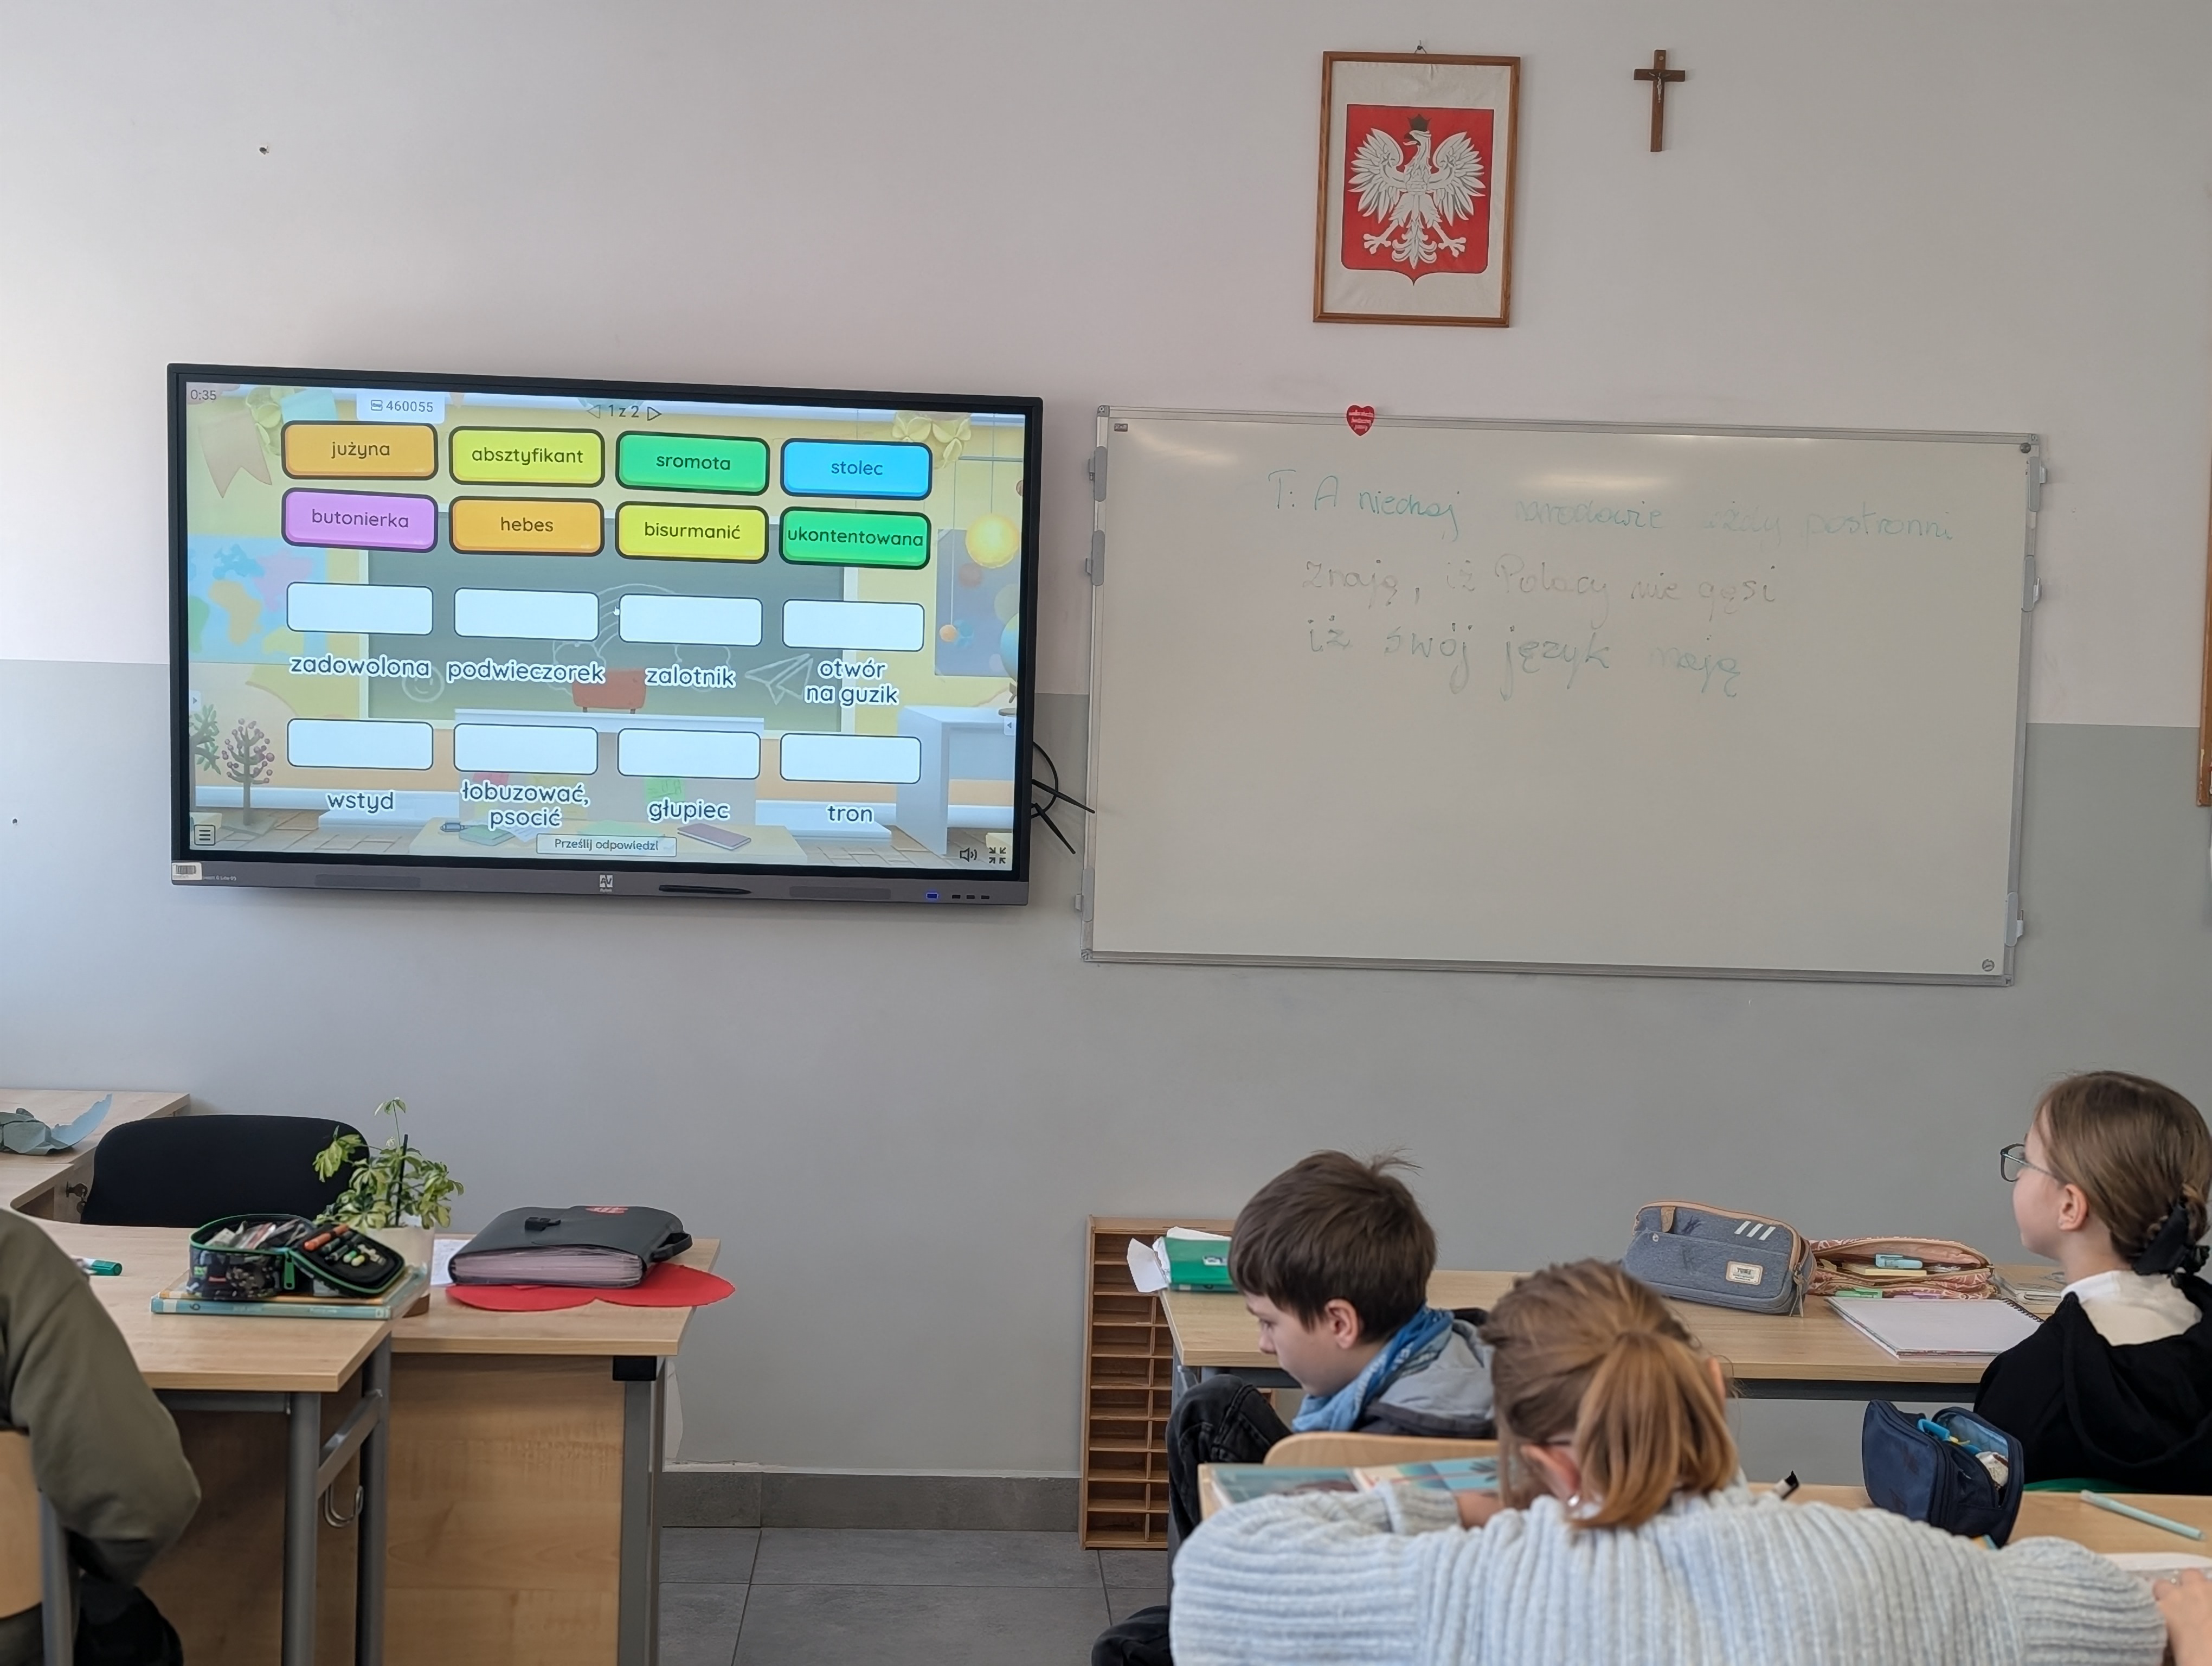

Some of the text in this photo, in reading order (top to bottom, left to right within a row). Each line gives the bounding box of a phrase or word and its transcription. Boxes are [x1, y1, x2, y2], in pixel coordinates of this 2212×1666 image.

[190, 389, 217, 401] 0:35
[385, 400, 434, 413] 460055
[608, 404, 639, 418] 1 z 2
[331, 440, 390, 459] jużyna
[472, 446, 584, 466] absztyfikant
[656, 454, 731, 471] sromota
[831, 460, 884, 476] stolec
[311, 509, 409, 528] butonierka
[1314, 475, 1339, 511] A
[1359, 490, 1461, 542] niechaj
[1806, 501, 1953, 549] postronni
[500, 516, 554, 533] hebes
[644, 521, 741, 540] bisurmanić
[787, 526, 923, 547] ukontentowana
[1495, 553, 1610, 630] Polacy
[1630, 572, 1682, 600] nie
[290, 656, 430, 678] zadowolona
[1307, 614, 1350, 652] iż
[1499, 624, 1610, 702] język
[448, 659, 604, 683] podwieczorek
[647, 666, 735, 687] zalotnik
[819, 660, 886, 678] otwór
[806, 684, 898, 706] na guzik
[327, 791, 394, 813] wstyd
[461, 782, 590, 806] łobuzować,
[490, 808, 561, 831] psocić
[649, 799, 729, 822] głupiec
[827, 805, 873, 823] tron
[555, 838, 659, 852] Prześlij odpowiedzi
